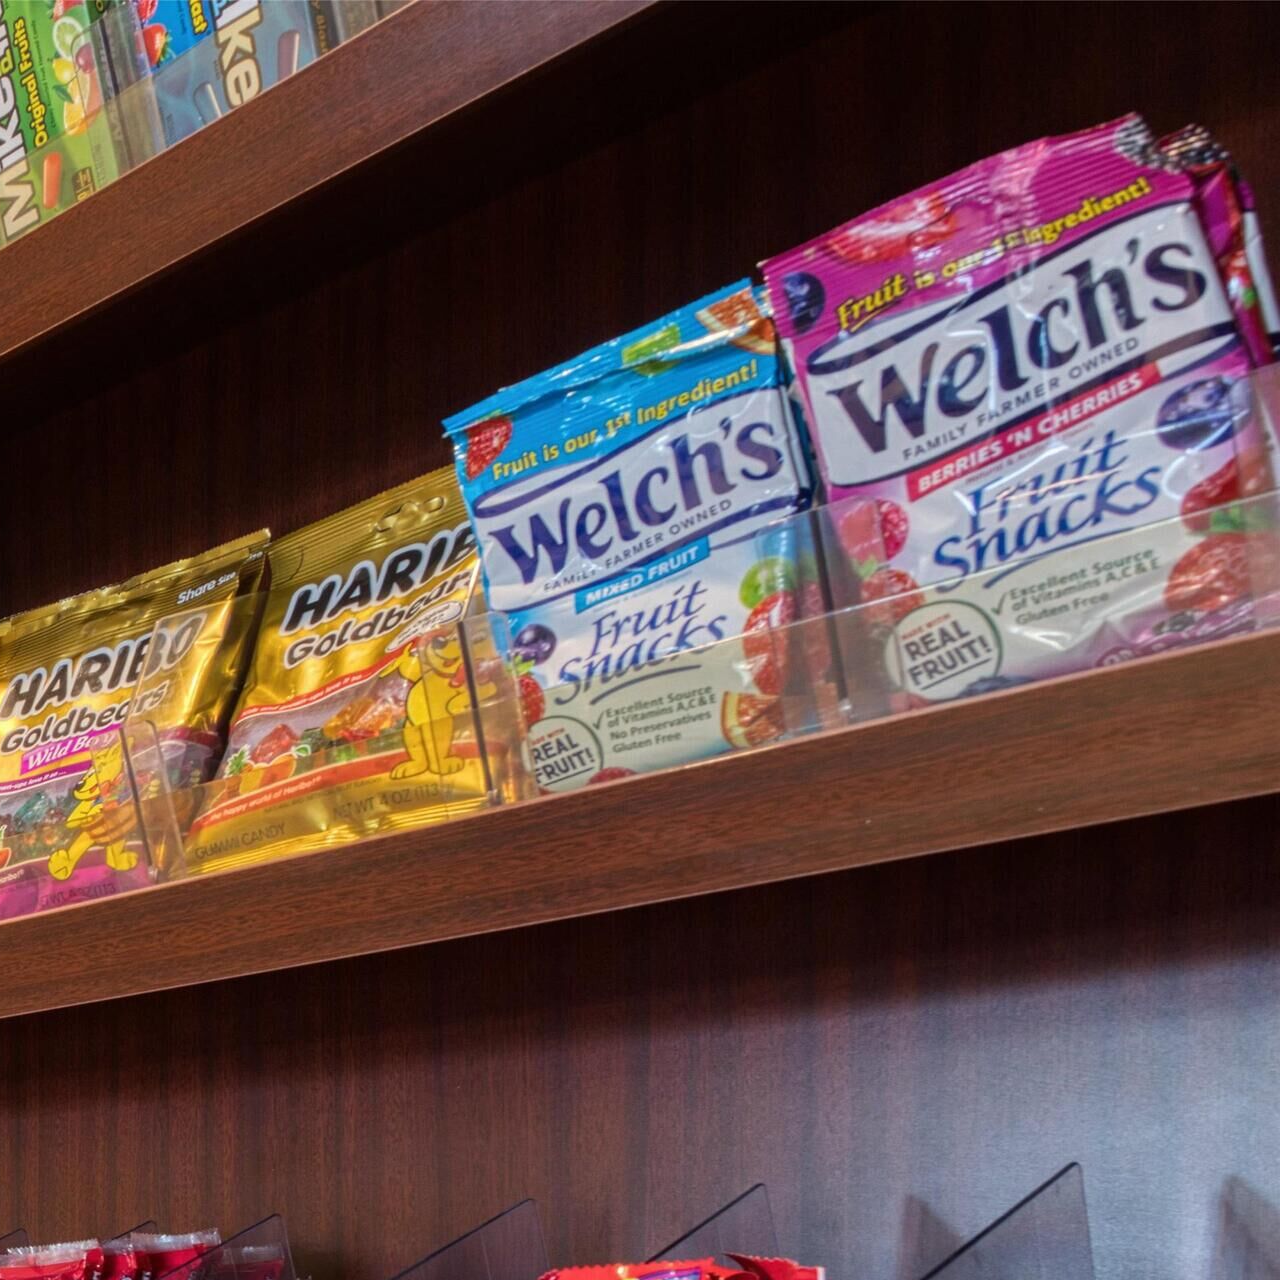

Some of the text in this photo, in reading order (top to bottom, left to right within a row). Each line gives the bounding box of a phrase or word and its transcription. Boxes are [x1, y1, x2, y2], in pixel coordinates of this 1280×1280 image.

[13, 17, 47, 147] Original Fruits
[825, 238, 1209, 456] Welch's
[492, 359, 760, 482] Fruit is our 1st Ingredient!
[902, 336, 1141, 462] FAMILY FARMER OWNED
[917, 372, 1143, 494] BERRIES 'N CHERRIES
[488, 416, 785, 587] Welch's
[968, 429, 1131, 535] Fruit
[544, 499, 734, 593] FAMILY FARMER OWNED
[932, 465, 1163, 594] Snacks
[177, 570, 237, 605] Share Size
[585, 546, 701, 604] MIXED FRUIT
[1009, 549, 1154, 601] Excellent Source
[591, 579, 708, 657] Fruit
[903, 618, 971, 662] REAL
[554, 613, 729, 705] Snacks
[908, 634, 992, 692] FRUIT!
[0, 682, 169, 755] Goldbears
[605, 685, 713, 719] Excellent Source
[610, 709, 712, 741] No Preservatives
[533, 733, 580, 764] REAL
[536, 747, 596, 785] FRUIT!
[612, 730, 682, 754] Gluten Free
